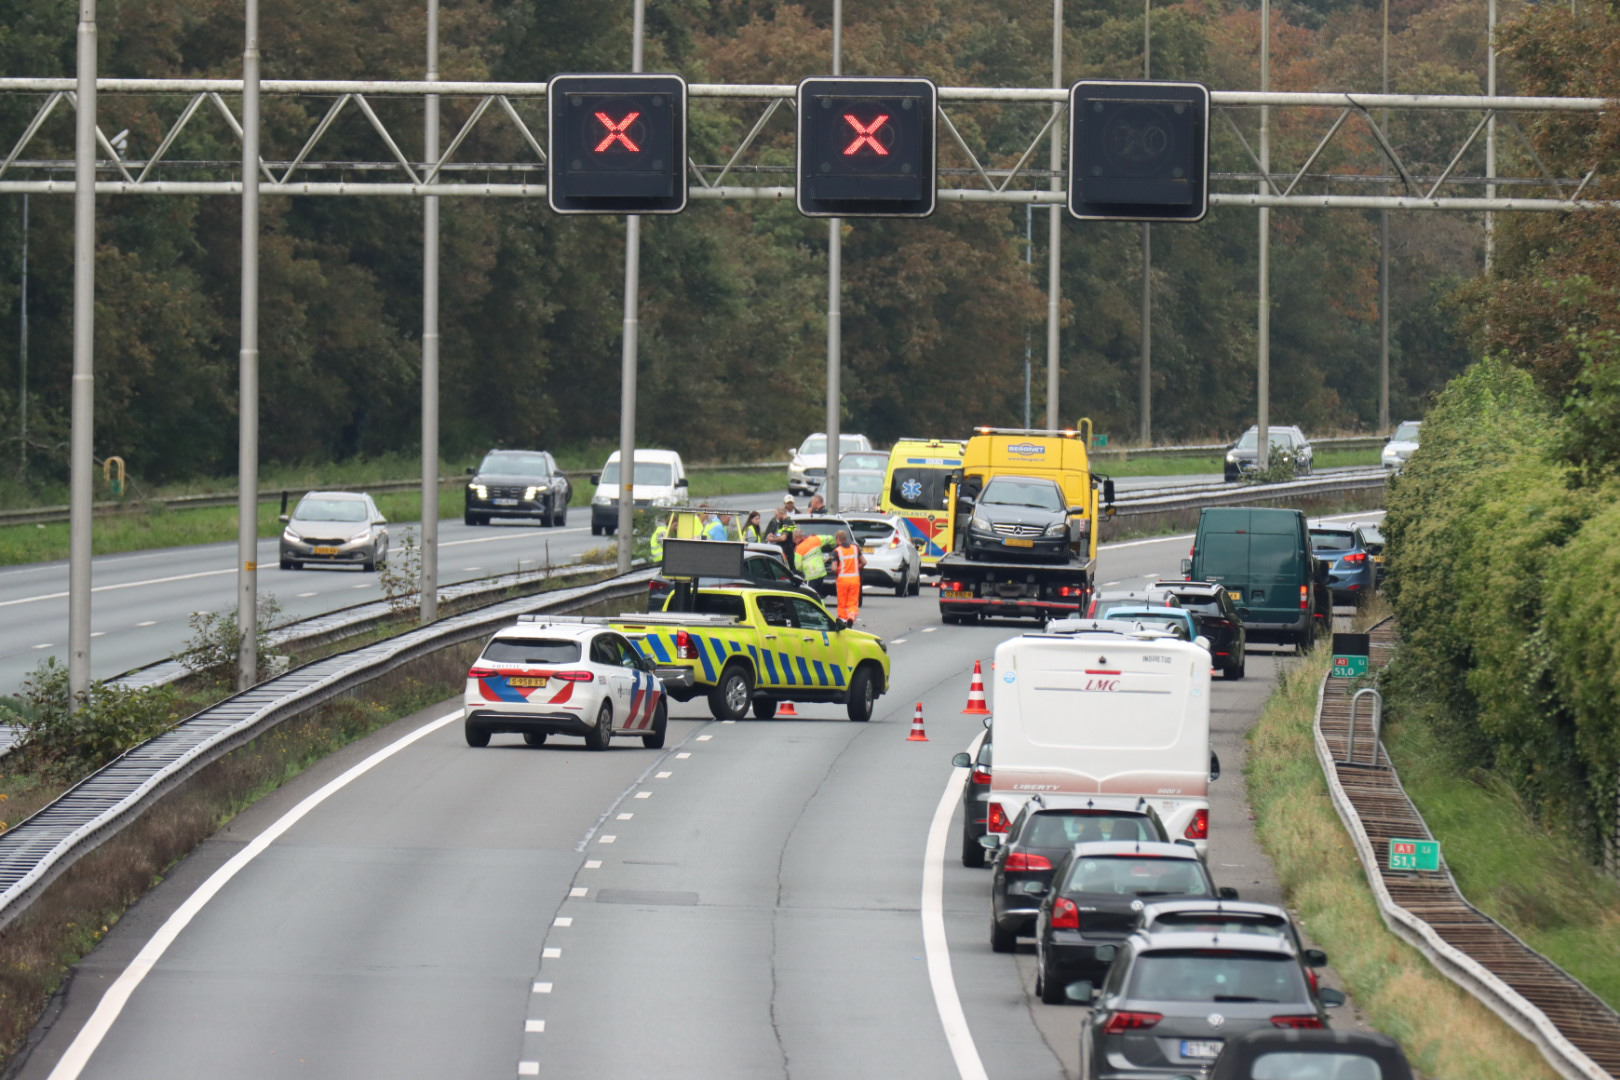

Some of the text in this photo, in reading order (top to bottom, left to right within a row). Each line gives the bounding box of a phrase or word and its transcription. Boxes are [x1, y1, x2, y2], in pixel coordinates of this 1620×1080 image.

[1008, 445, 1045, 453] BERGNET
[1085, 679, 1120, 691] LMC
[1398, 844, 1411, 853] A1
